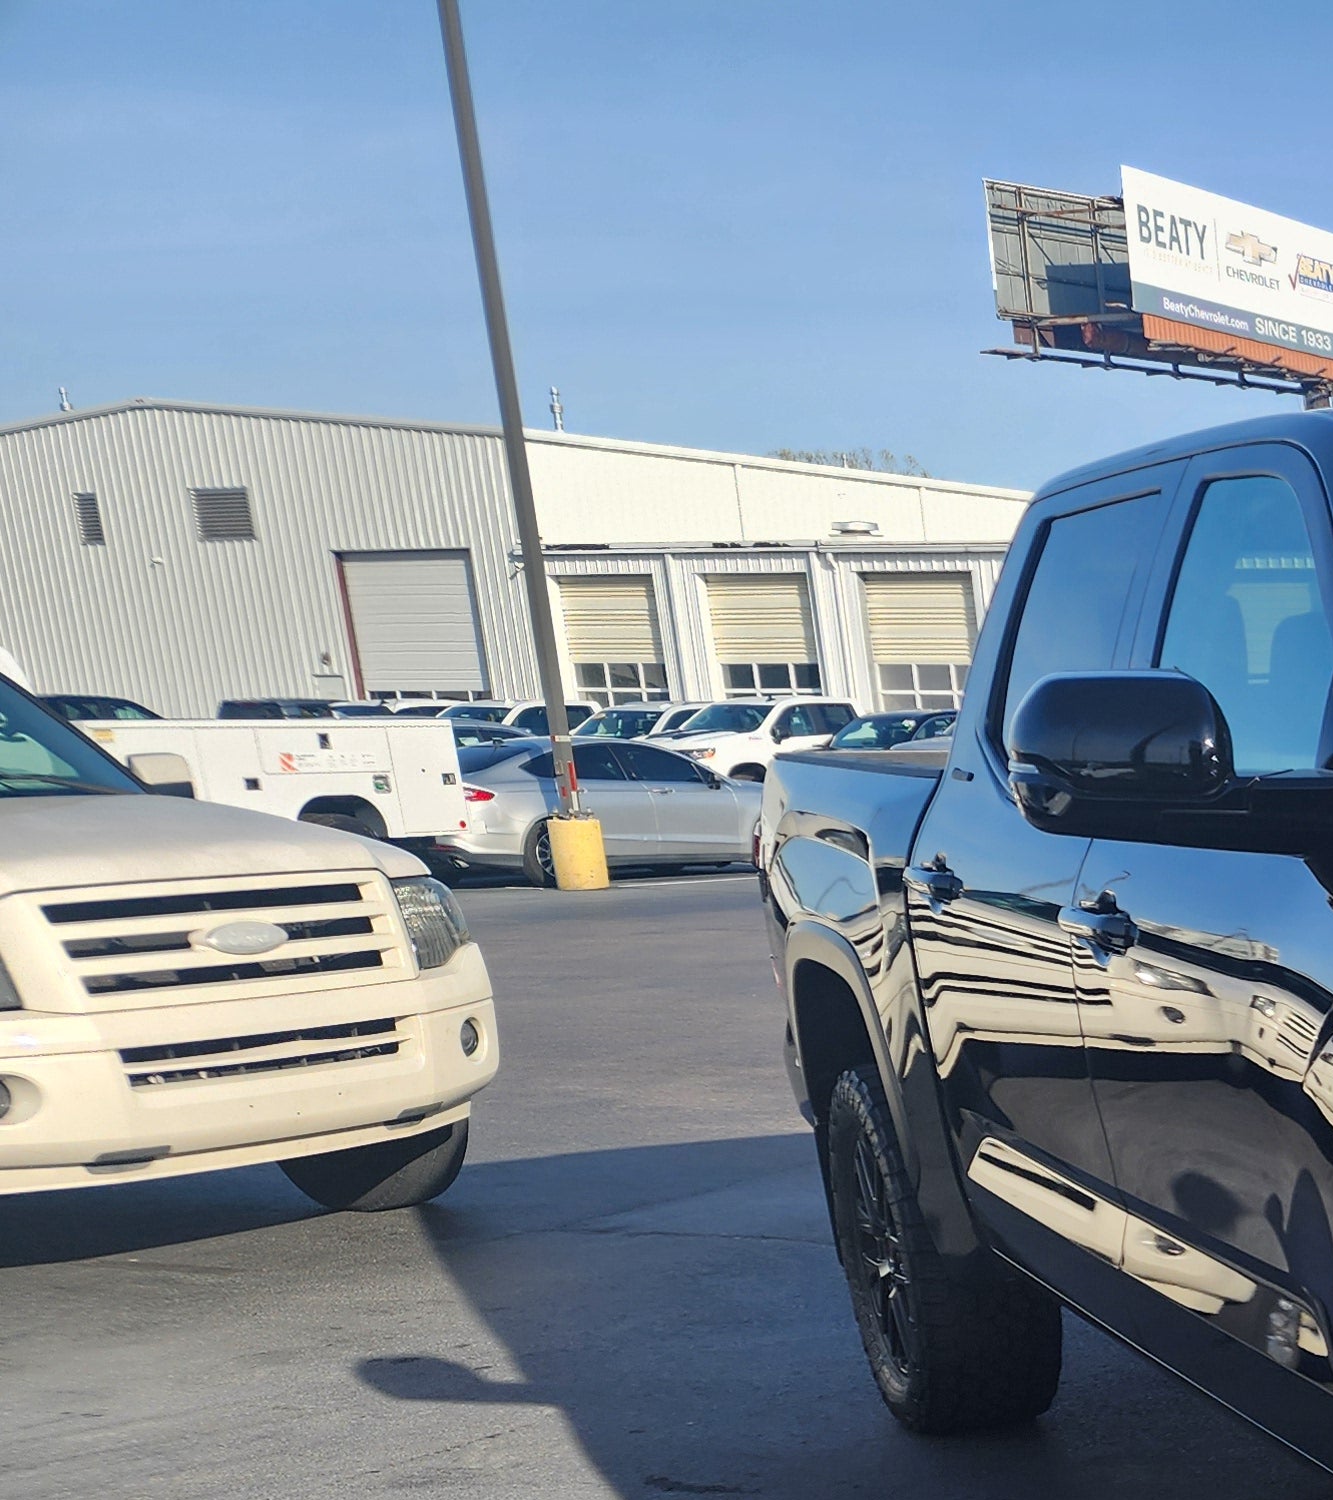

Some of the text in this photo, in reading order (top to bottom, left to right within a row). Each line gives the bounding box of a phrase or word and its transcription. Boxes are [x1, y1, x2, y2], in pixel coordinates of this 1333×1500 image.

[1136, 204, 1207, 260] BEATY
[1226, 265, 1280, 291] CHEVROLET
[1162, 297, 1332, 351] BeatyChevrolet.com SINCE 1933
